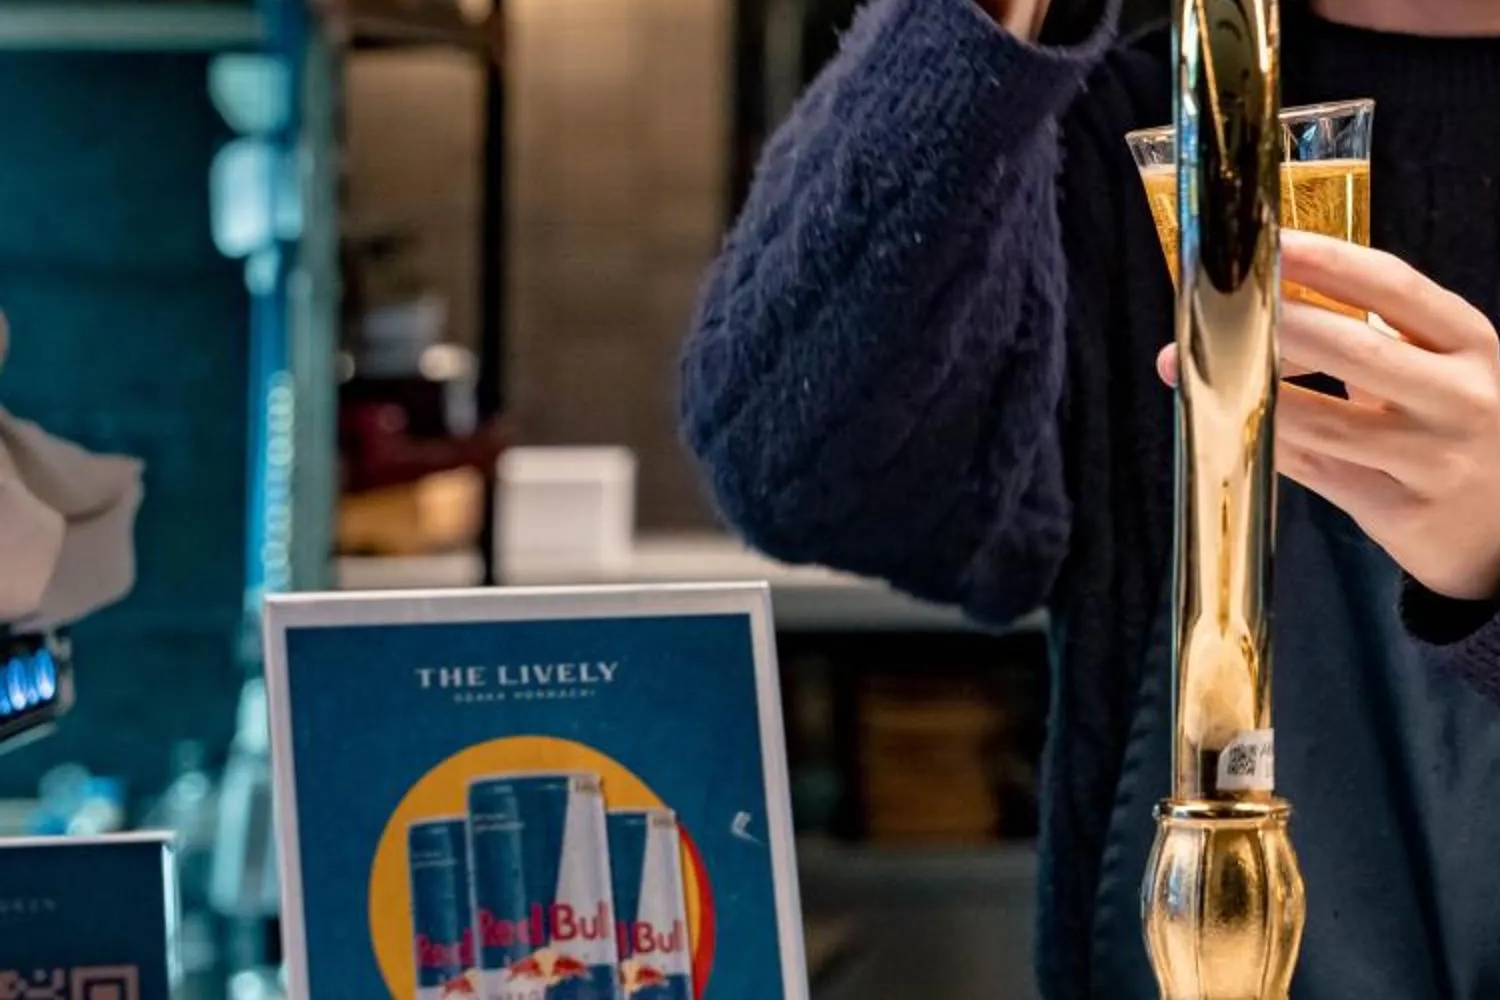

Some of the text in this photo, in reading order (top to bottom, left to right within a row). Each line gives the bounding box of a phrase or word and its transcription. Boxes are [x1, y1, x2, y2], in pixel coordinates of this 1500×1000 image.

[415, 661, 619, 689] THE LIVELY
[477, 903, 543, 946] Red
